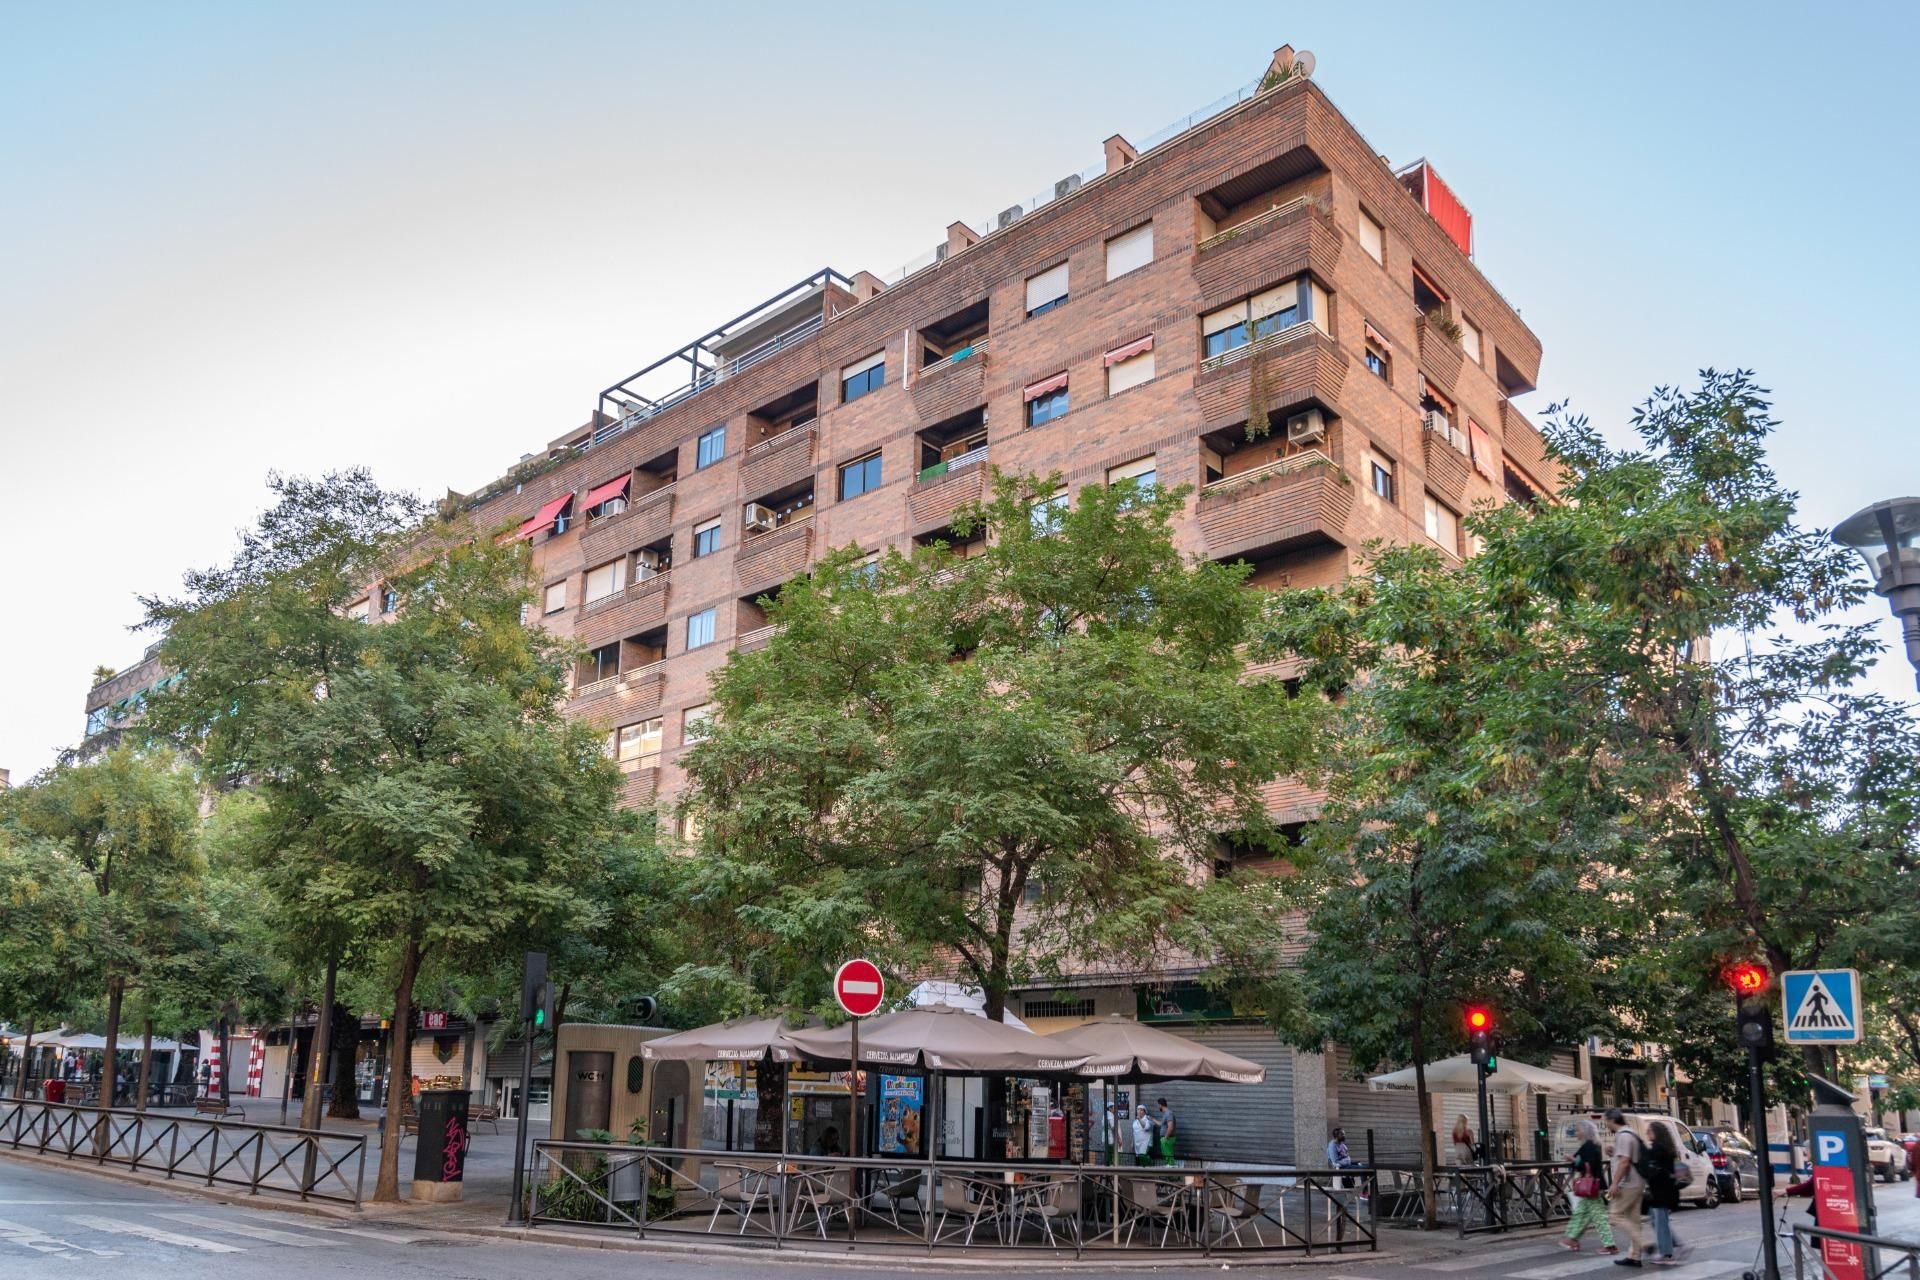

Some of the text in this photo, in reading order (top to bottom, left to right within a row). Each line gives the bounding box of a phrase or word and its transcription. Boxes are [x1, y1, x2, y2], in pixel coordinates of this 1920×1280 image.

[428, 1013, 444, 1026] eac
[1038, 1059, 1063, 1069] CERVEZAS
[1386, 1082, 1415, 1091] Alhambra
[1818, 1136, 1844, 1162] P
